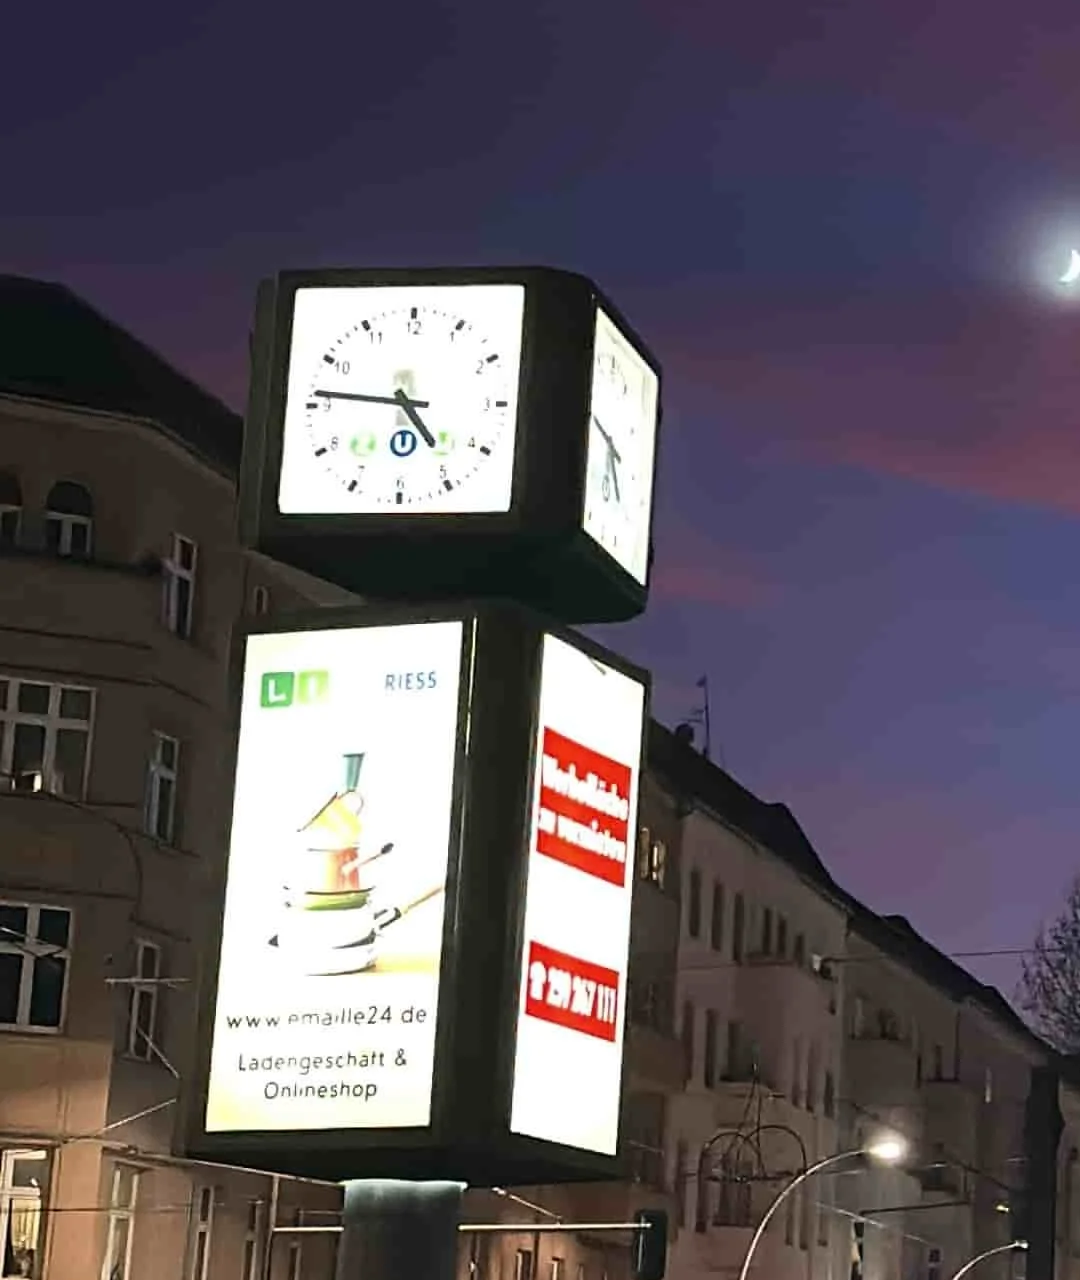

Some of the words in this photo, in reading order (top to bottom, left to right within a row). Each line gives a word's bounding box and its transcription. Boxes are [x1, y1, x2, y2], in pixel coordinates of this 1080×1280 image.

[407, 321, 422, 336] 12
[369, 330, 383, 345] 11
[332, 359, 351, 376] 10
[475, 359, 485, 376] 2
[329, 435, 339, 452] 8
[466, 436, 476, 449] 4
[439, 464, 448, 480] 5
[396, 475, 405, 490] 6
[384, 671, 438, 692] RIESS
[226, 1005, 428, 1029] wwwemaille24de
[394, 1048, 408, 1067] &
[263, 1080, 379, 1103] Onlineshop
